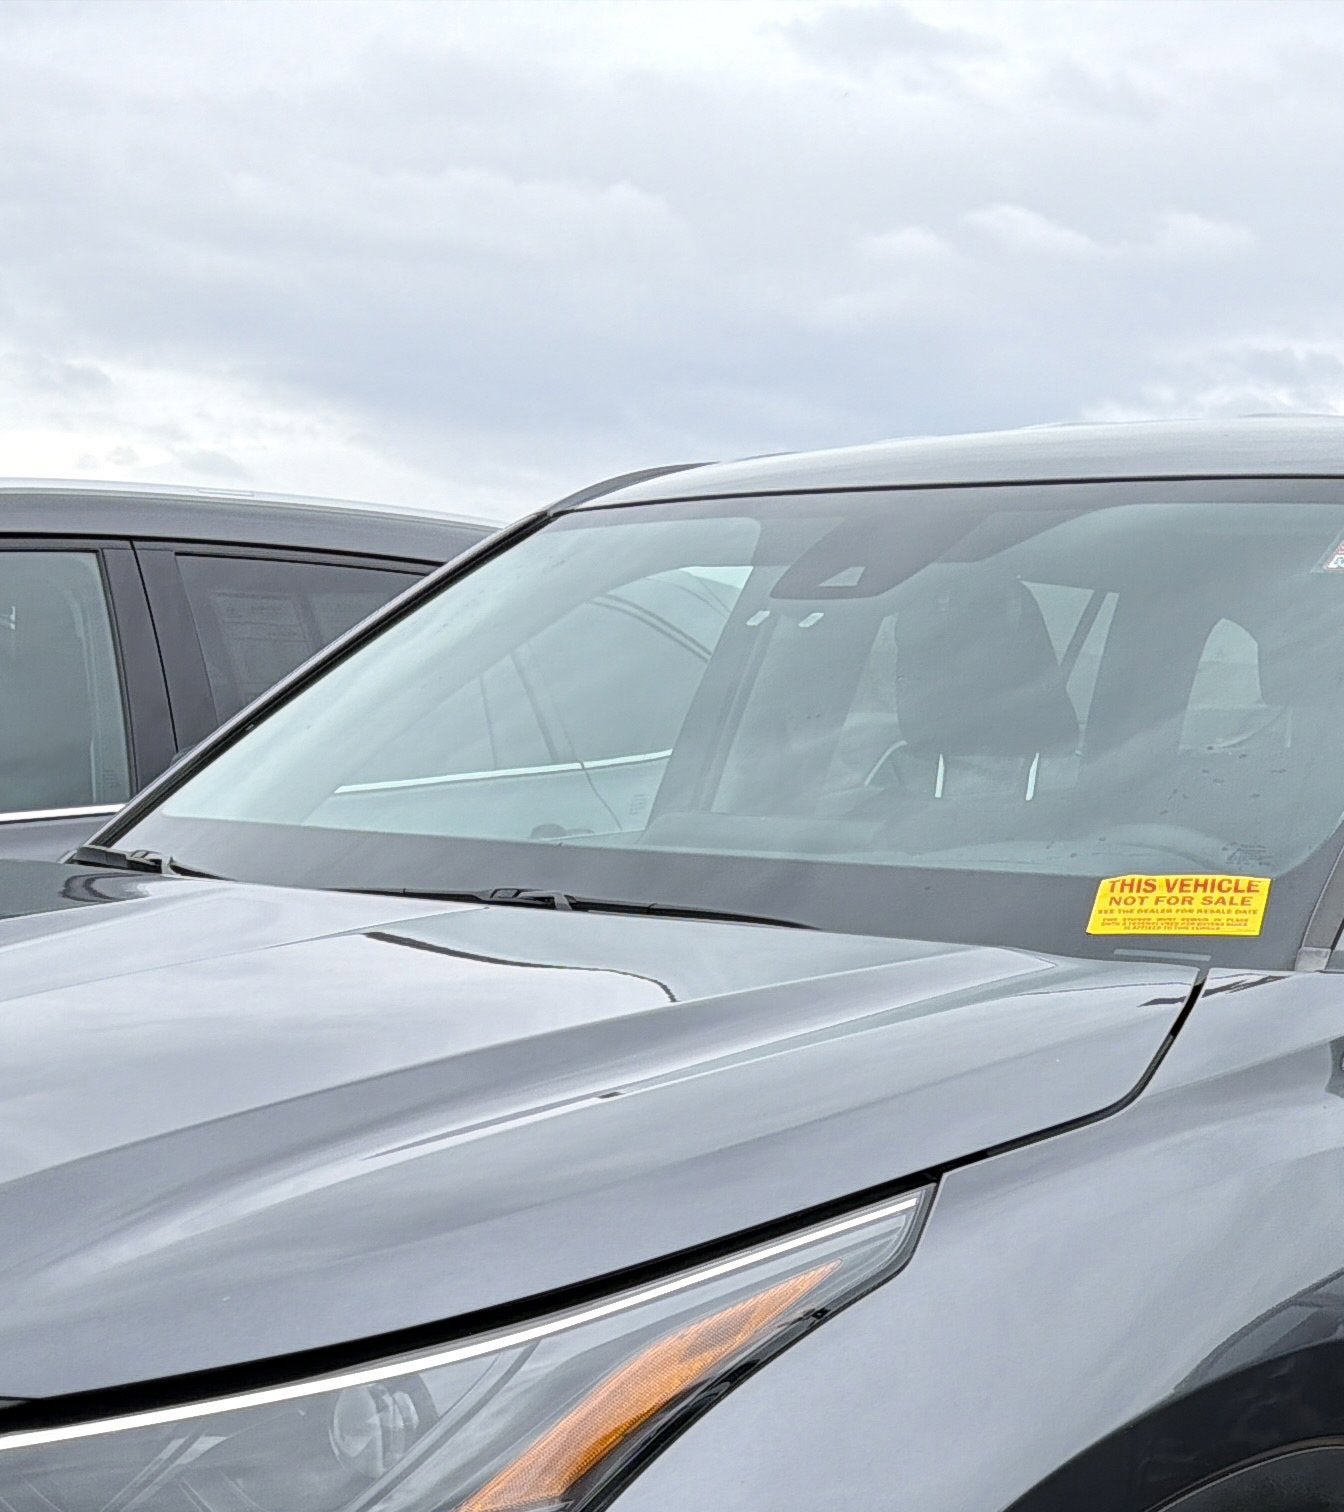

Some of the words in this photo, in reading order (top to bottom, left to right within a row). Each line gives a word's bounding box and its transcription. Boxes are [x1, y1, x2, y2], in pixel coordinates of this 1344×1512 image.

[1109, 878, 1157, 893] THIS
[1165, 878, 1261, 893] VEHICLE
[1109, 896, 1149, 906] NOT
[1154, 896, 1193, 906] FOR
[1201, 896, 1253, 906] SALE
